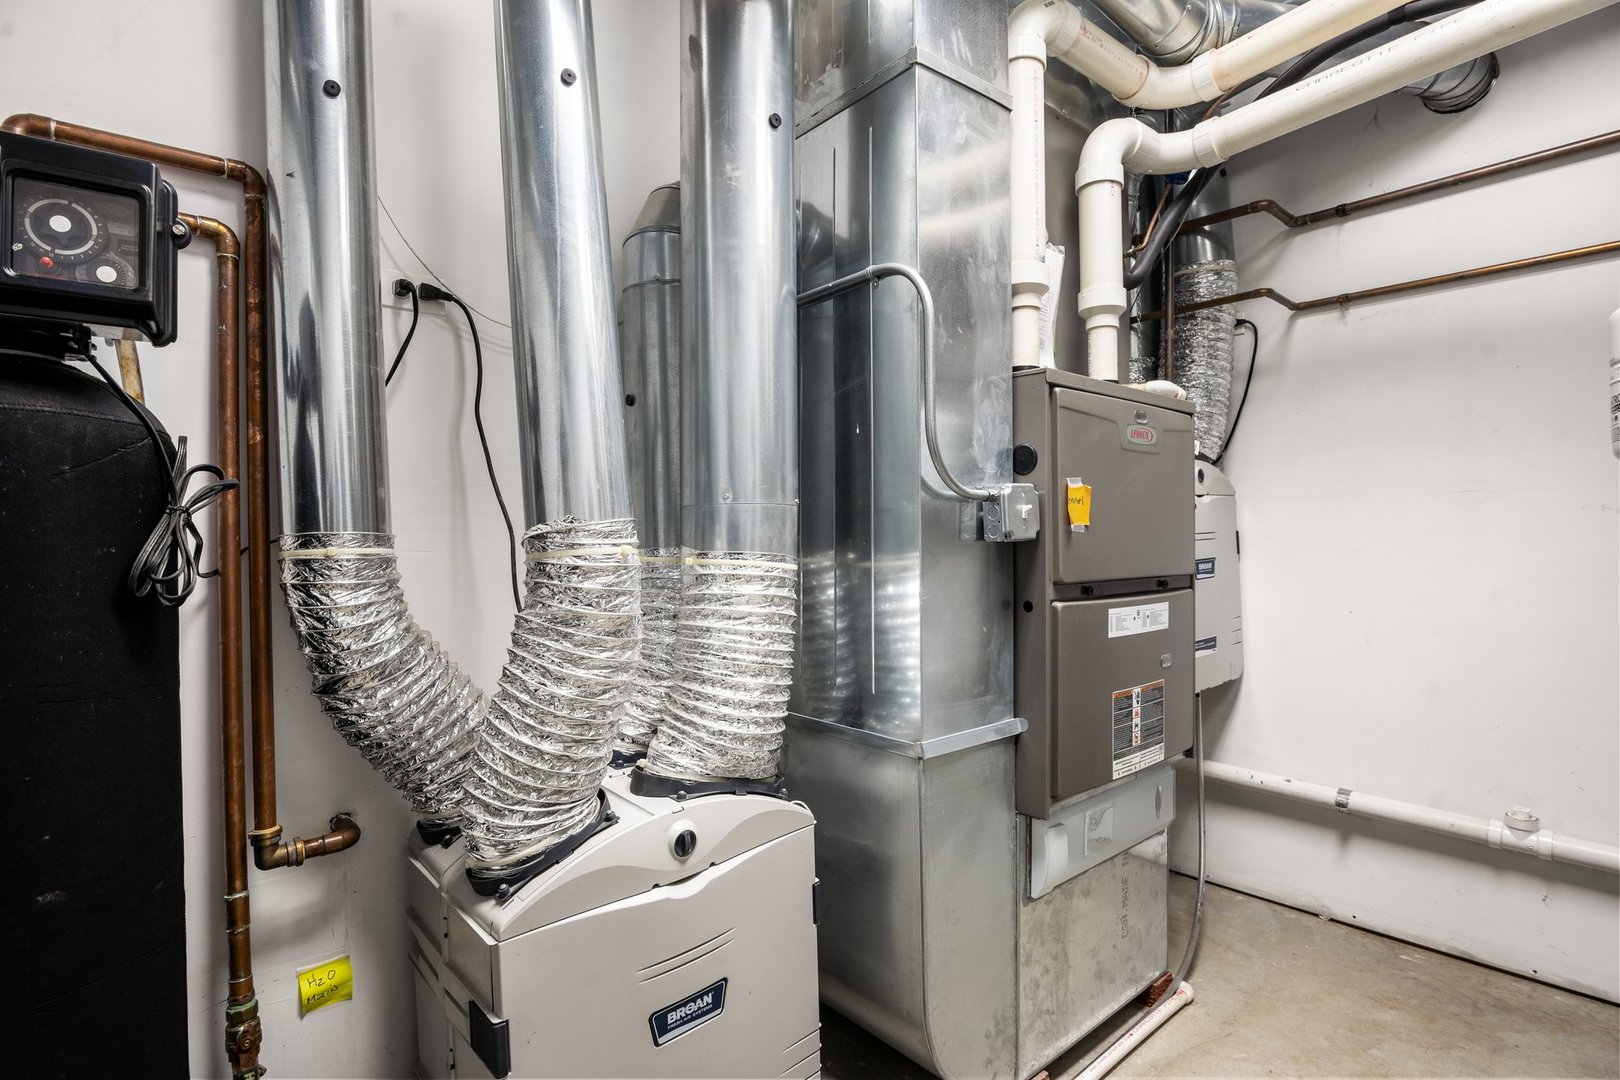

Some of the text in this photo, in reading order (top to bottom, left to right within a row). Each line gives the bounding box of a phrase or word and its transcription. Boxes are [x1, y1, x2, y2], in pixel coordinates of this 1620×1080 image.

[667, 992, 713, 1025] BROAN
[667, 1004, 713, 1030] FRESH AIR SYSTEMS
